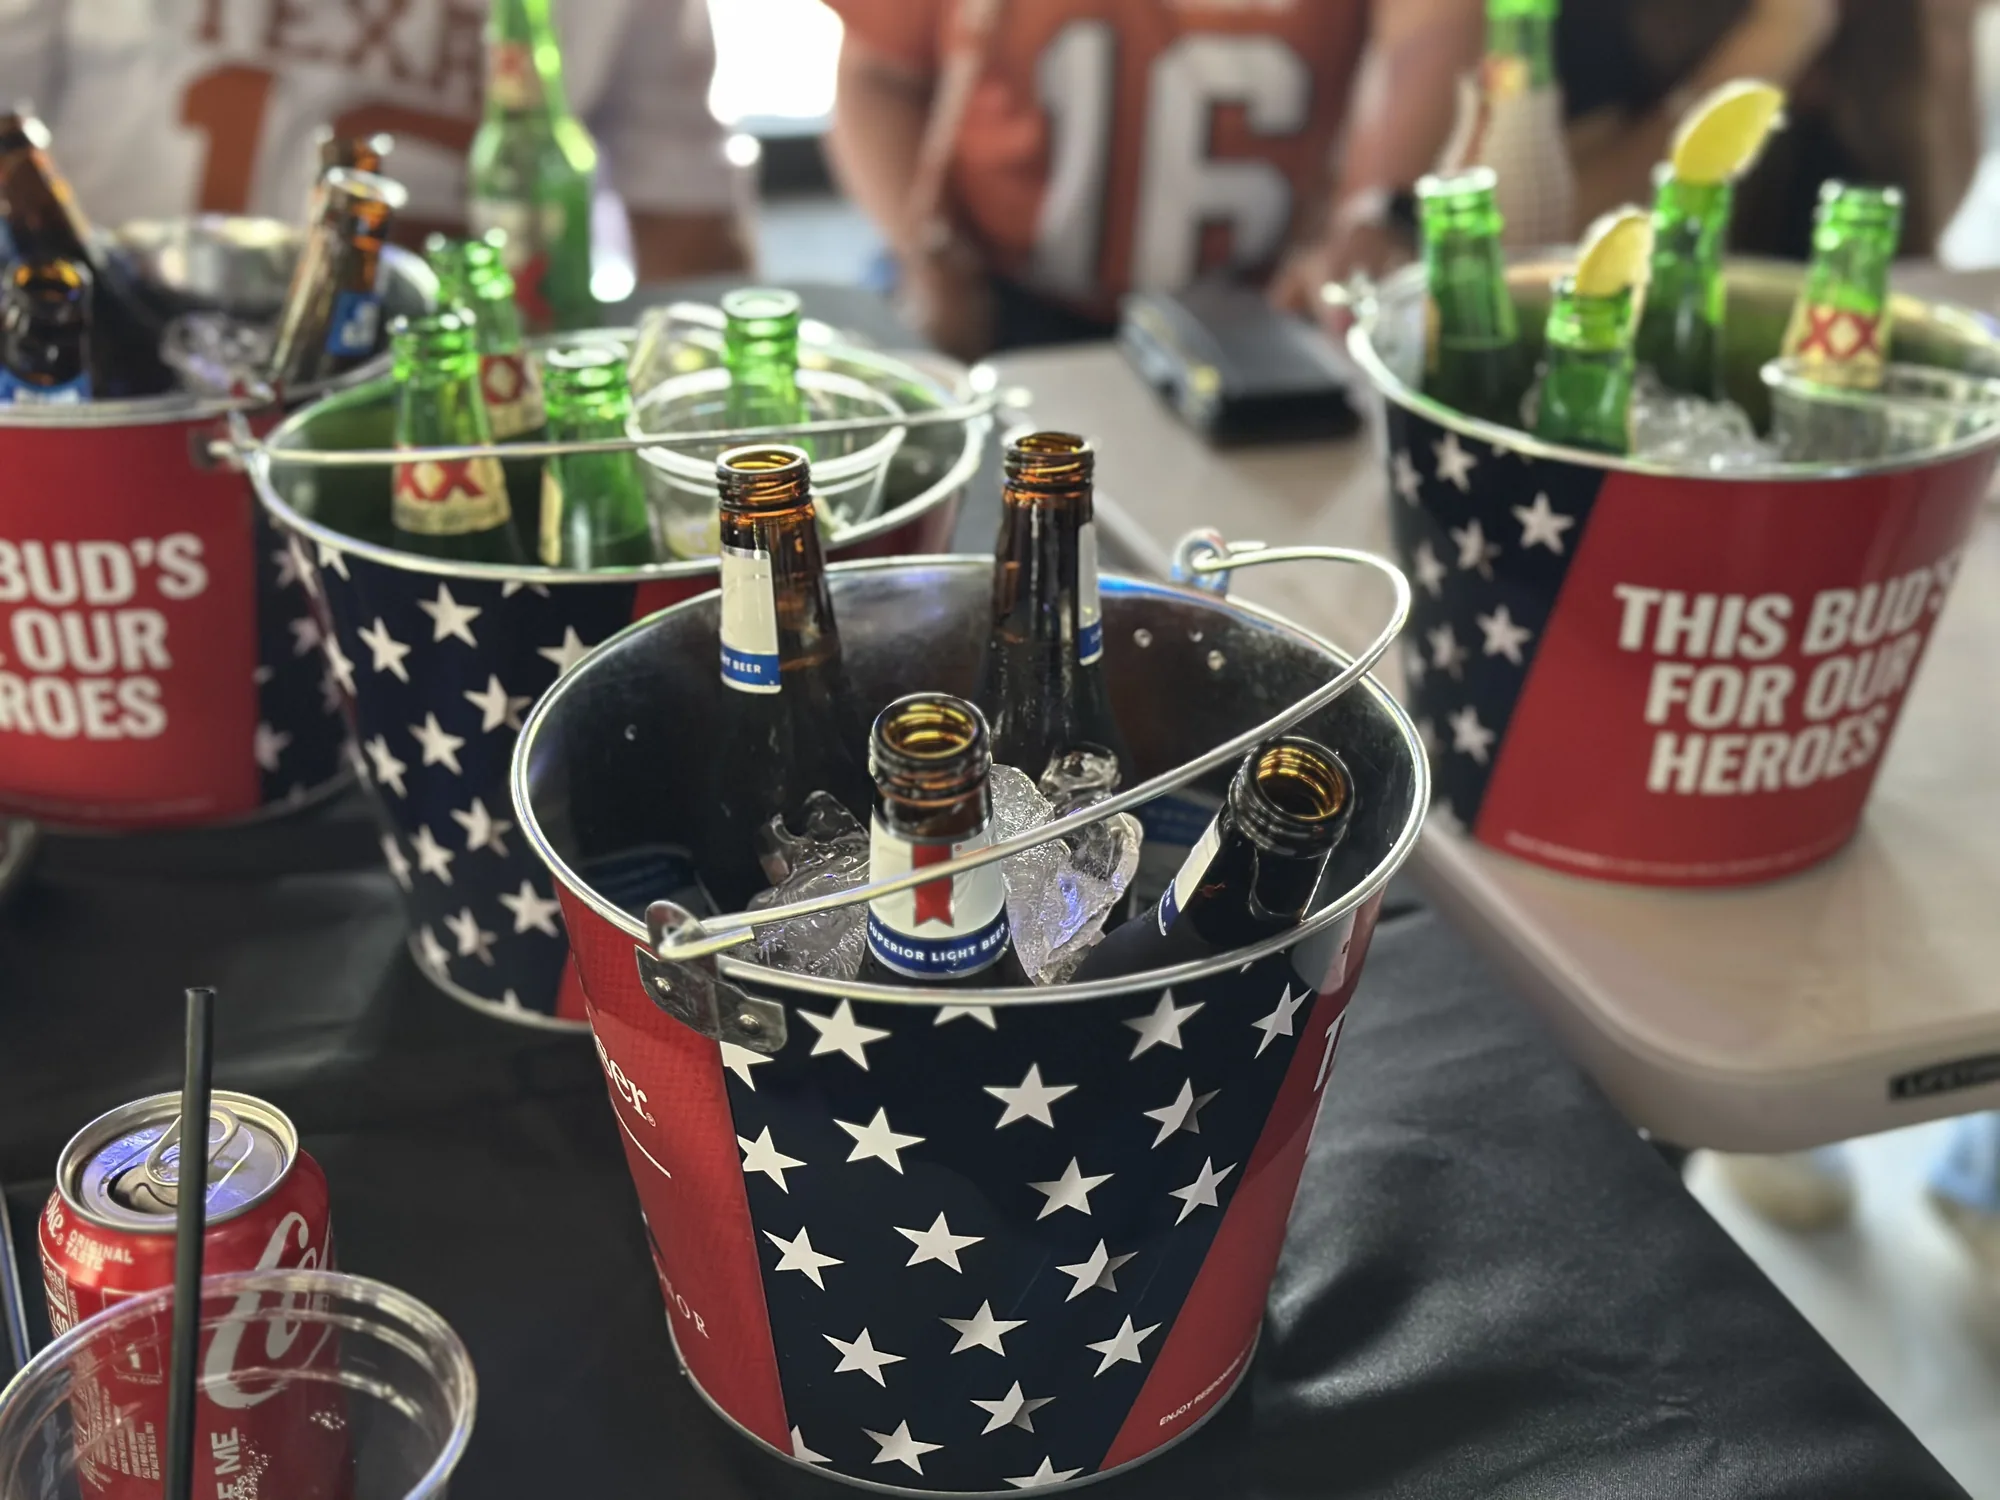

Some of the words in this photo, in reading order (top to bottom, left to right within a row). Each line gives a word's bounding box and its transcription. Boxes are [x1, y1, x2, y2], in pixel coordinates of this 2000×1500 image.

[1036, 20, 1312, 303] 16
[10, 607, 173, 674] OUR
[1613, 582, 1794, 660] THIS
[732, 659, 762, 674] BEER
[1644, 661, 1796, 729] FOR
[1803, 631, 1922, 721] OUR
[0, 671, 168, 740] ROES
[1646, 703, 1889, 796] HEROES
[868, 921, 925, 961] SUPERIOR
[931, 945, 976, 962] LIGHT
[64, 1239, 105, 1273] TASTE
[69, 1228, 134, 1266] ORIGINAL
[1159, 1399, 1193, 1427] ENJOY
[210, 1427, 242, 1476] ME
